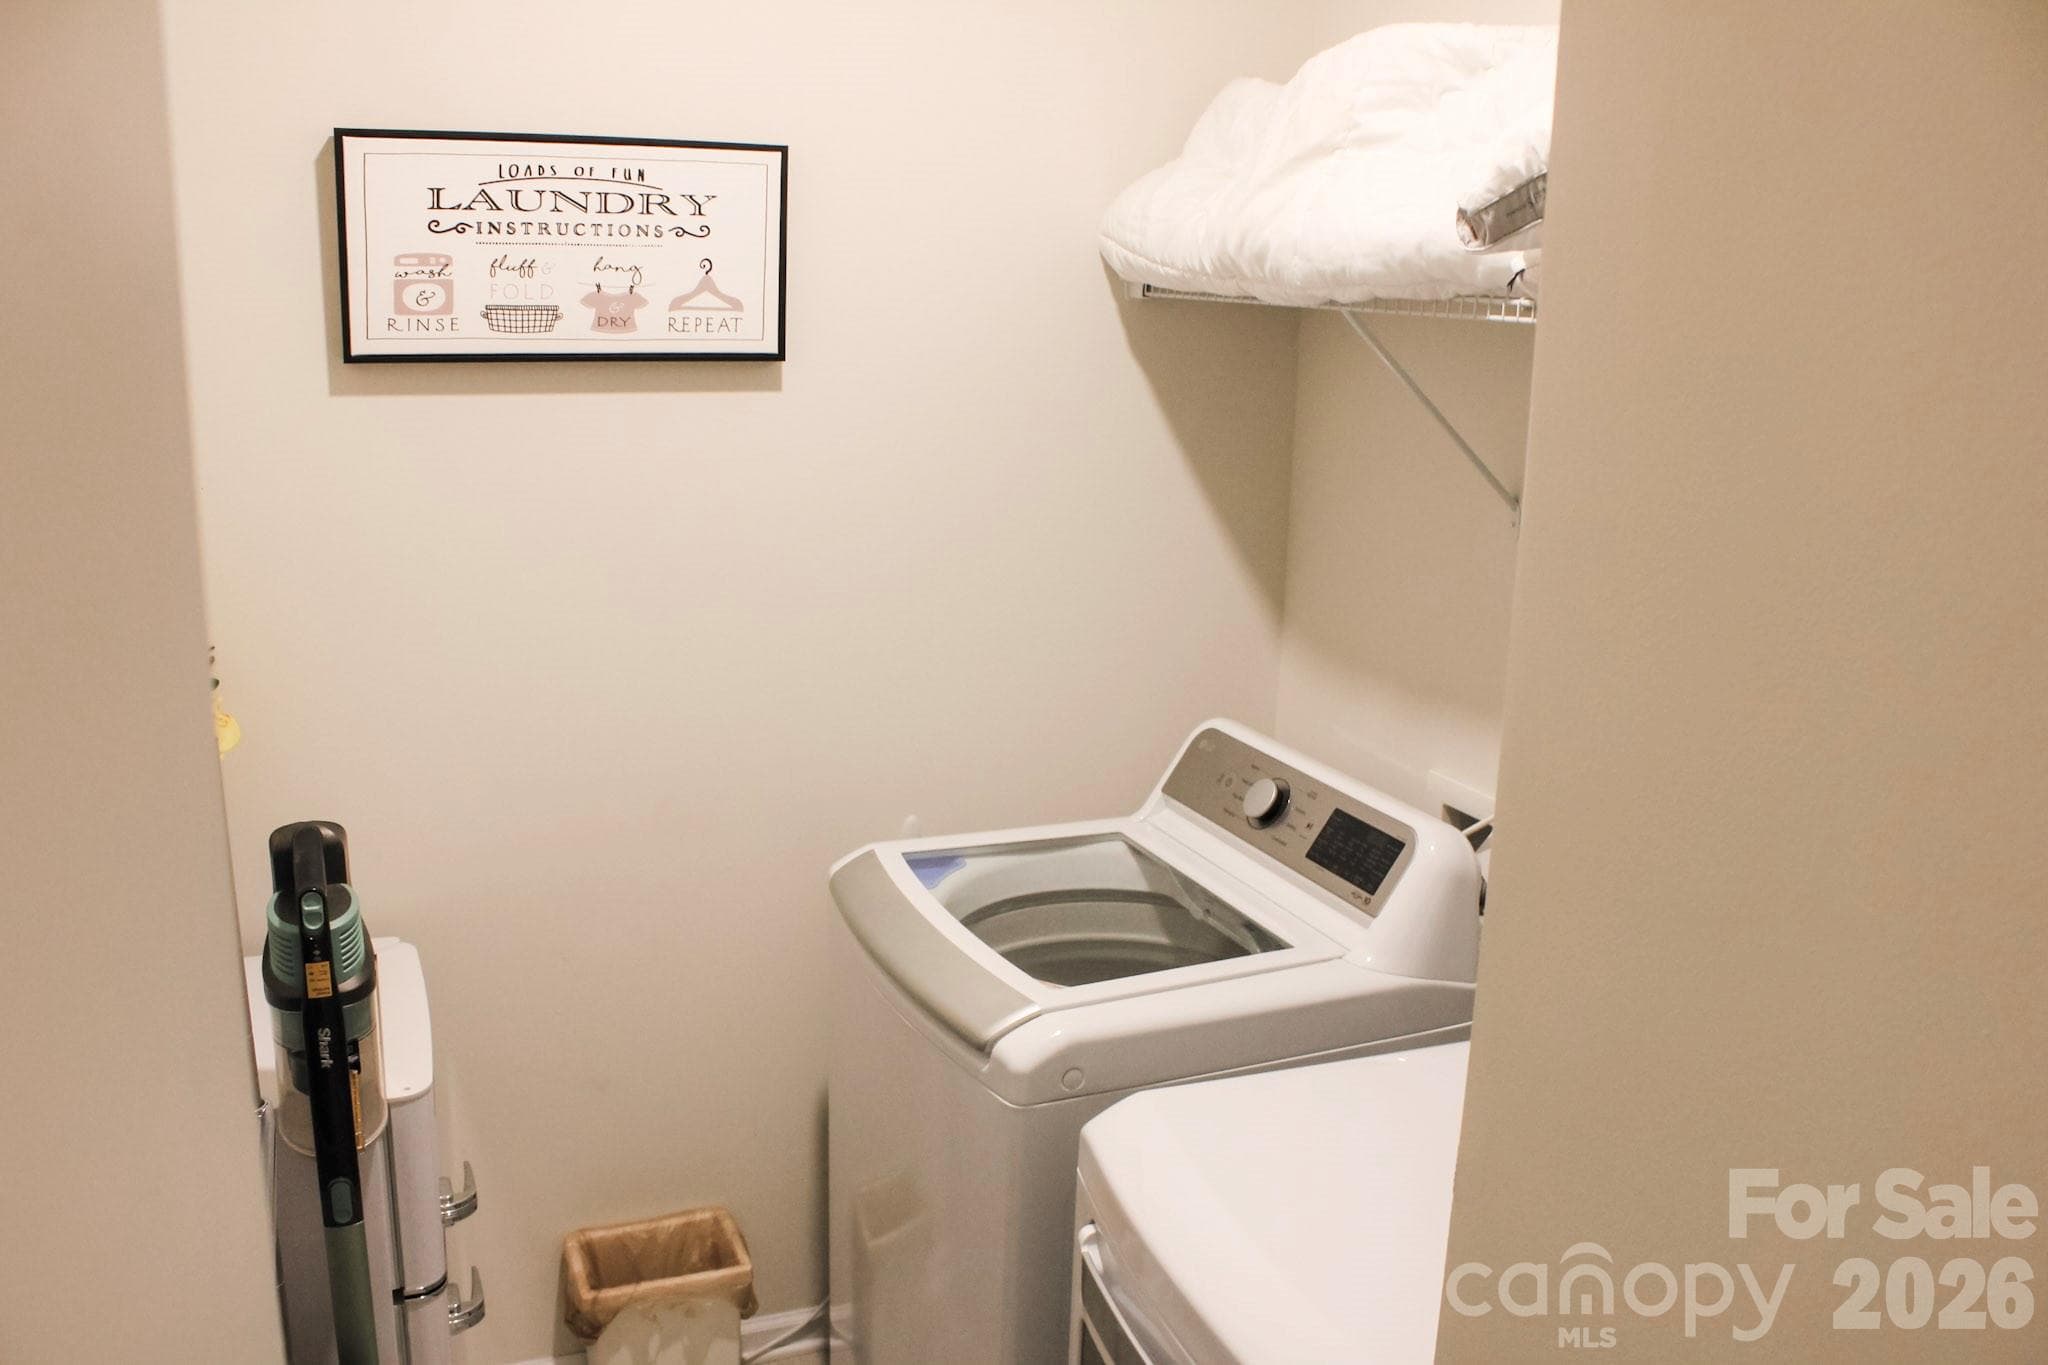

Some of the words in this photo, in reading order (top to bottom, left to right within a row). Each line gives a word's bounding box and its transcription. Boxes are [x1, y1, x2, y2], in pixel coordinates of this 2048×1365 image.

[498, 163, 557, 179] LOADS
[574, 165, 596, 178] OF
[611, 167, 646, 183] FUN
[427, 187, 717, 217] LAUNDRY
[475, 221, 664, 239] INSTRUCTIONS
[394, 262, 454, 279] wash
[489, 254, 539, 278] fluff
[592, 256, 643, 284] hang
[489, 282, 555, 300] FOLD
[386, 317, 460, 333] RINSE
[596, 316, 632, 329] DRY
[667, 317, 745, 334] REPEAT
[318, 1027, 333, 1068] Shark
